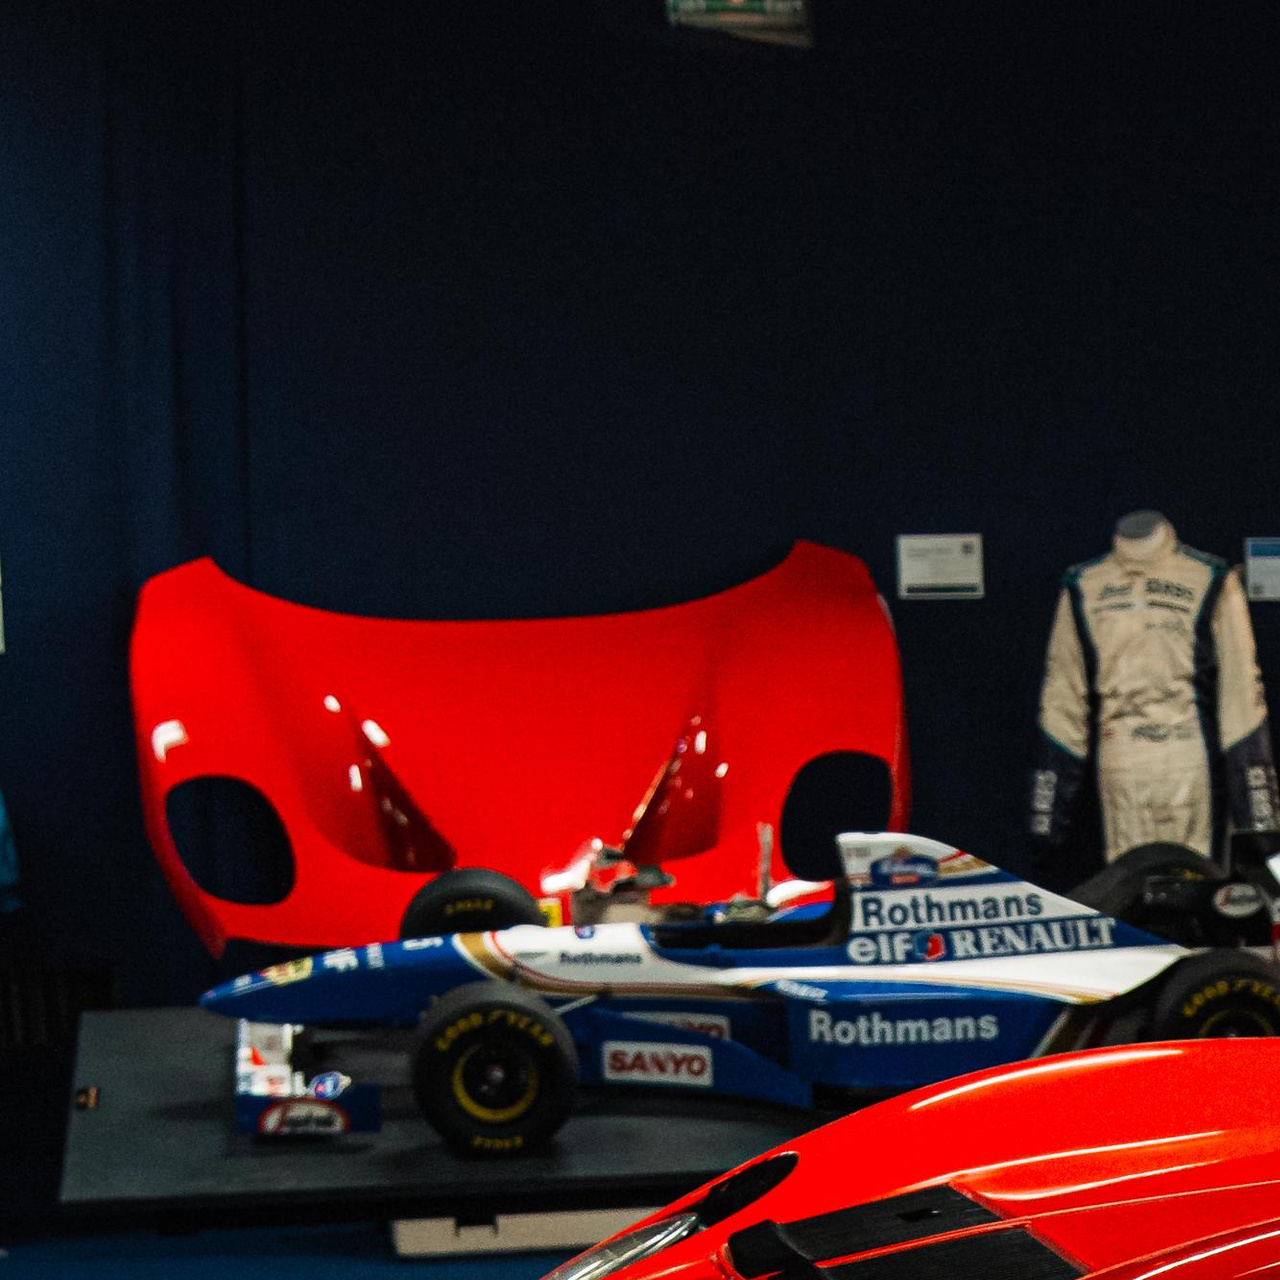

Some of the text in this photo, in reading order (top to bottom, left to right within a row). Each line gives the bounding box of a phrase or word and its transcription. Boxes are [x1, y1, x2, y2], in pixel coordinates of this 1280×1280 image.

[860, 891, 1044, 928] Rothmans
[847, 917, 1116, 963] elf RENAULT
[808, 1008, 999, 1045] Rothmans
[608, 1049, 708, 1077] SANYO
